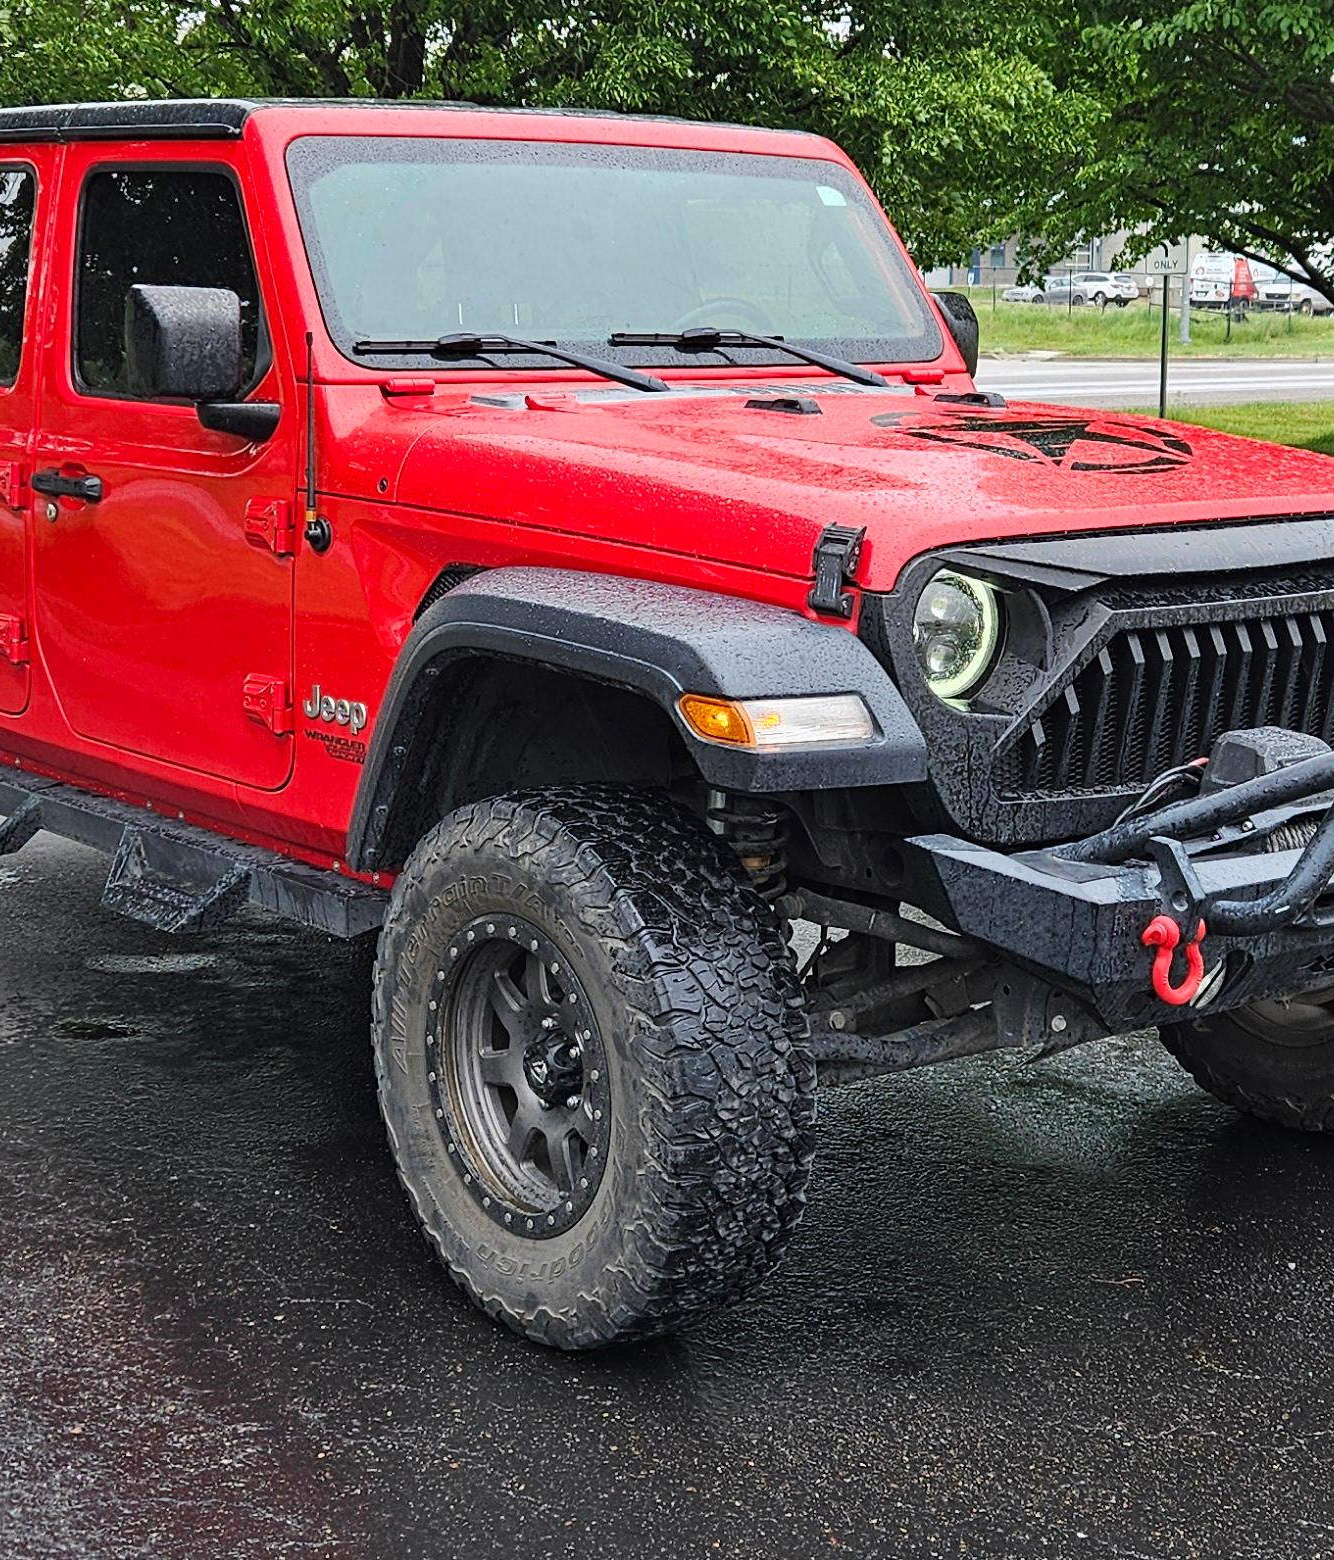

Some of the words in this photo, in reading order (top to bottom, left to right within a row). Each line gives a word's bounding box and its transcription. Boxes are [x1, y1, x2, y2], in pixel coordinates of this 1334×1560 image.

[1154, 260, 1178, 269] ONLY
[303, 685, 367, 735] Jeep
[304, 729, 365, 751] WRANGLER
